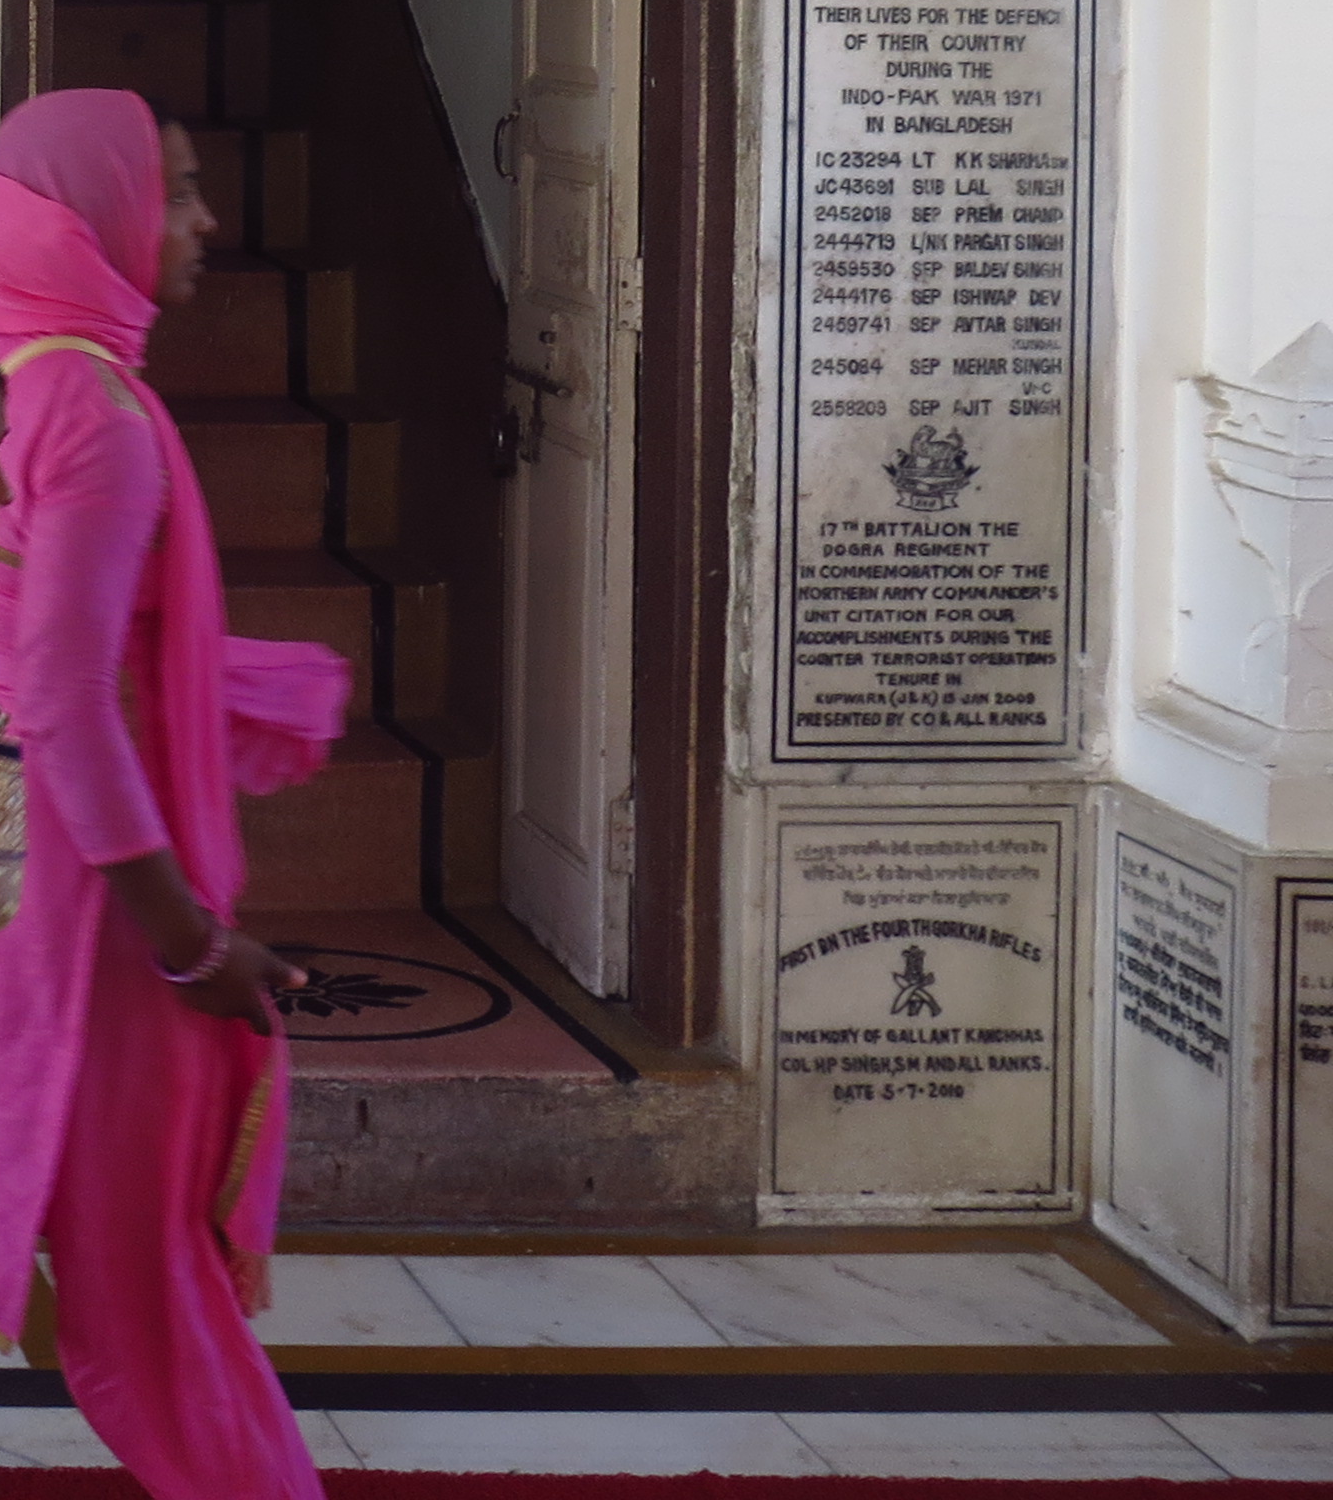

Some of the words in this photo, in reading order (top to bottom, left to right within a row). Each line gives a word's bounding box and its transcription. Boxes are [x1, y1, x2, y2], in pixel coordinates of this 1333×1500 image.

[952, 90, 996, 106] WAR
[1003, 90, 1041, 106] 1971
[866, 116, 884, 132] IN
[894, 116, 1012, 133] BANGLADESH
[865, 522, 971, 538] BATTALION
[979, 522, 1019, 537] THE
[824, 543, 884, 557] DOGRA
[895, 543, 990, 556] REGIMENT
